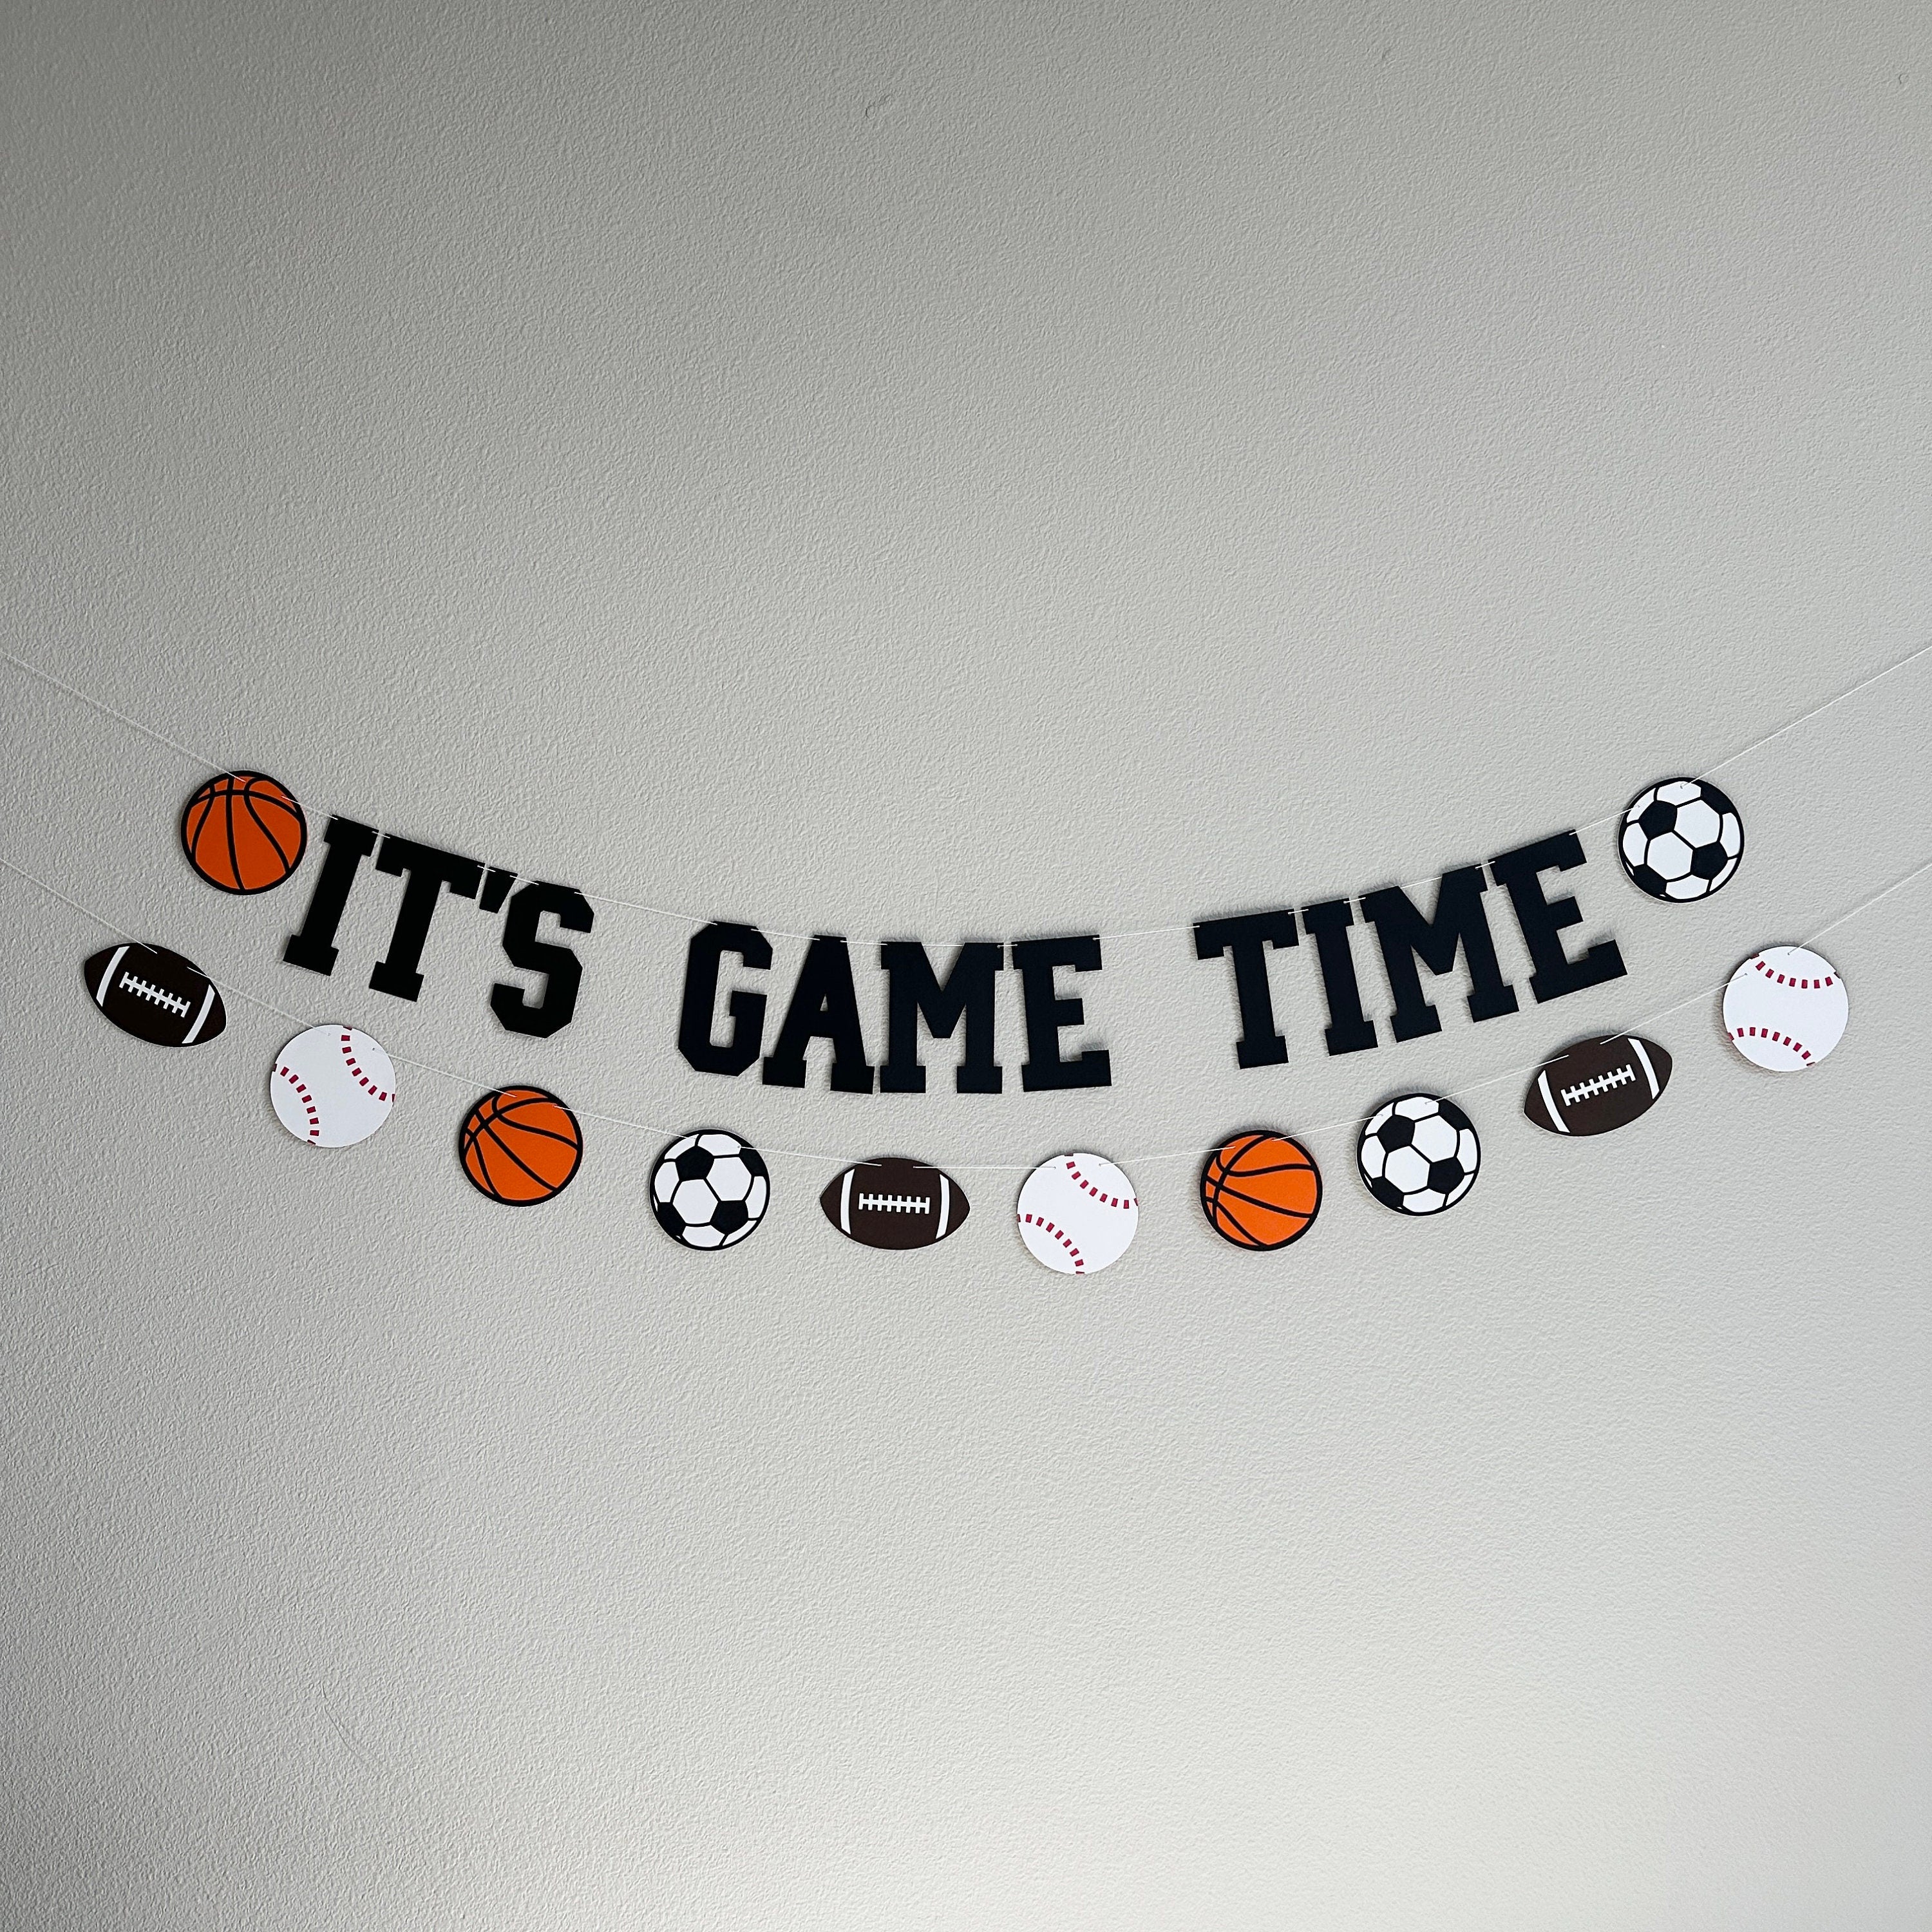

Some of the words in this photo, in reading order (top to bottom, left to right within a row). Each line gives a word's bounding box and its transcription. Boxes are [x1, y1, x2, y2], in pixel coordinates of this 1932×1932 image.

[282, 813, 596, 1039] IT'S
[677, 921, 1112, 1095] GAME
[1193, 829, 1628, 1070] TIME
